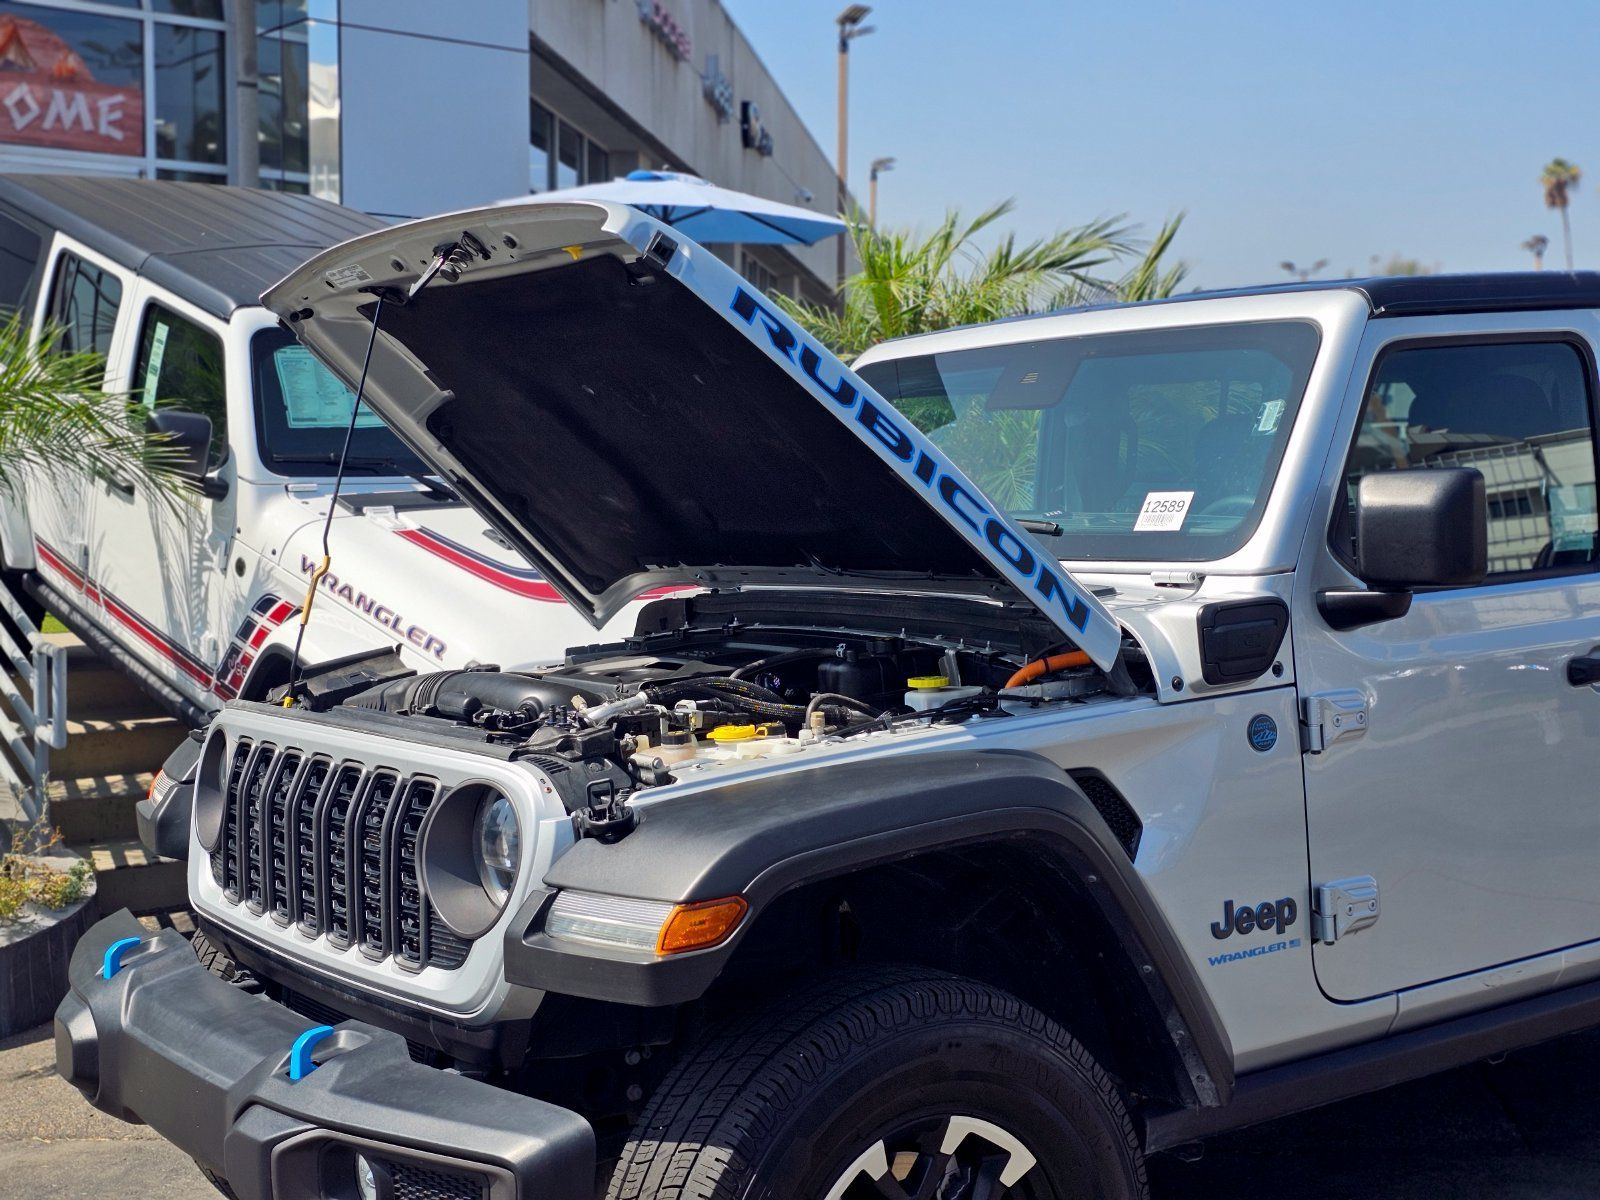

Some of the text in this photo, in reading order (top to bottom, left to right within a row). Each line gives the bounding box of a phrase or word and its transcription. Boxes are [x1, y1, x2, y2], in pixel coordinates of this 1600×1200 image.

[730, 286, 1092, 634] RUBICON
[1143, 500, 1186, 513] 12589
[301, 554, 448, 661] WRANGLER
[1210, 897, 1298, 940] Jeep
[1208, 941, 1287, 966] WRANGLER
